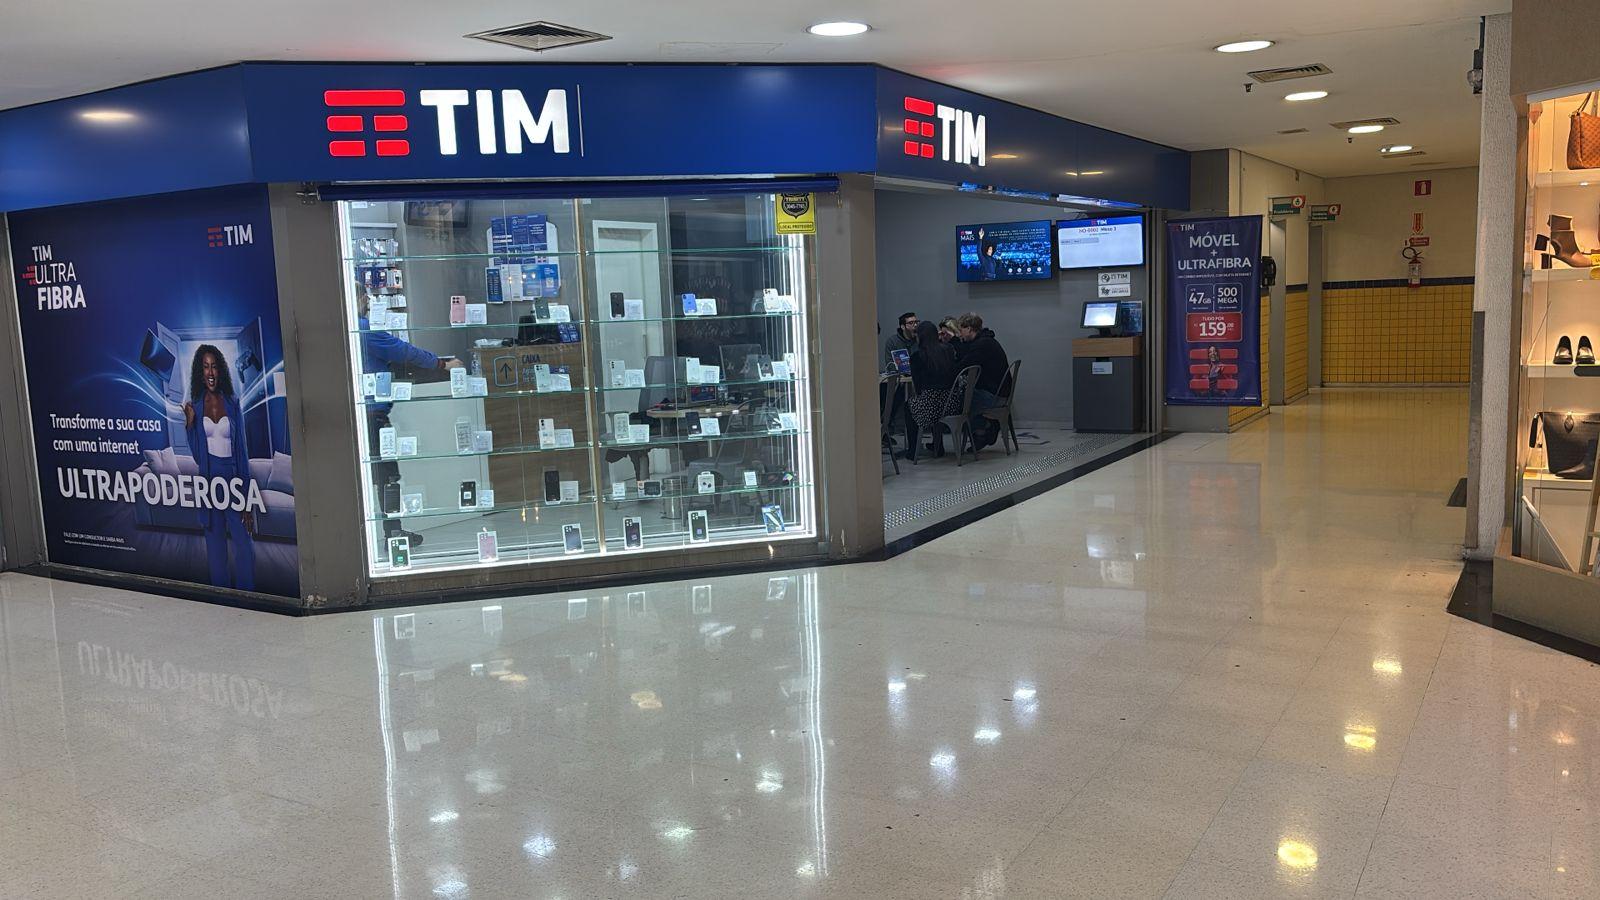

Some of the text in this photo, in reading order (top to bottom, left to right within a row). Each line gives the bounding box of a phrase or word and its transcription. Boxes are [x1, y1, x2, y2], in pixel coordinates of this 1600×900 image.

[420, 89, 570, 155] TIM
[937, 104, 986, 167] TIM
[224, 224, 253, 246] TIM
[1189, 231, 1240, 249] MÓVEL
[32, 245, 53, 262] TIM
[1177, 257, 1252, 271] ULTRAFIBRA
[34, 262, 77, 285] ULTRA
[37, 284, 87, 311] FIBRA
[1217, 287, 1238, 297] 500
[1199, 321, 1227, 337] 159
[522, 354, 541, 363] CAIXA
[50, 413, 162, 432] Transforme a sua casa
[53, 437, 140, 455] com uma internet
[57, 467, 267, 513] ULTRAPODEROSA
